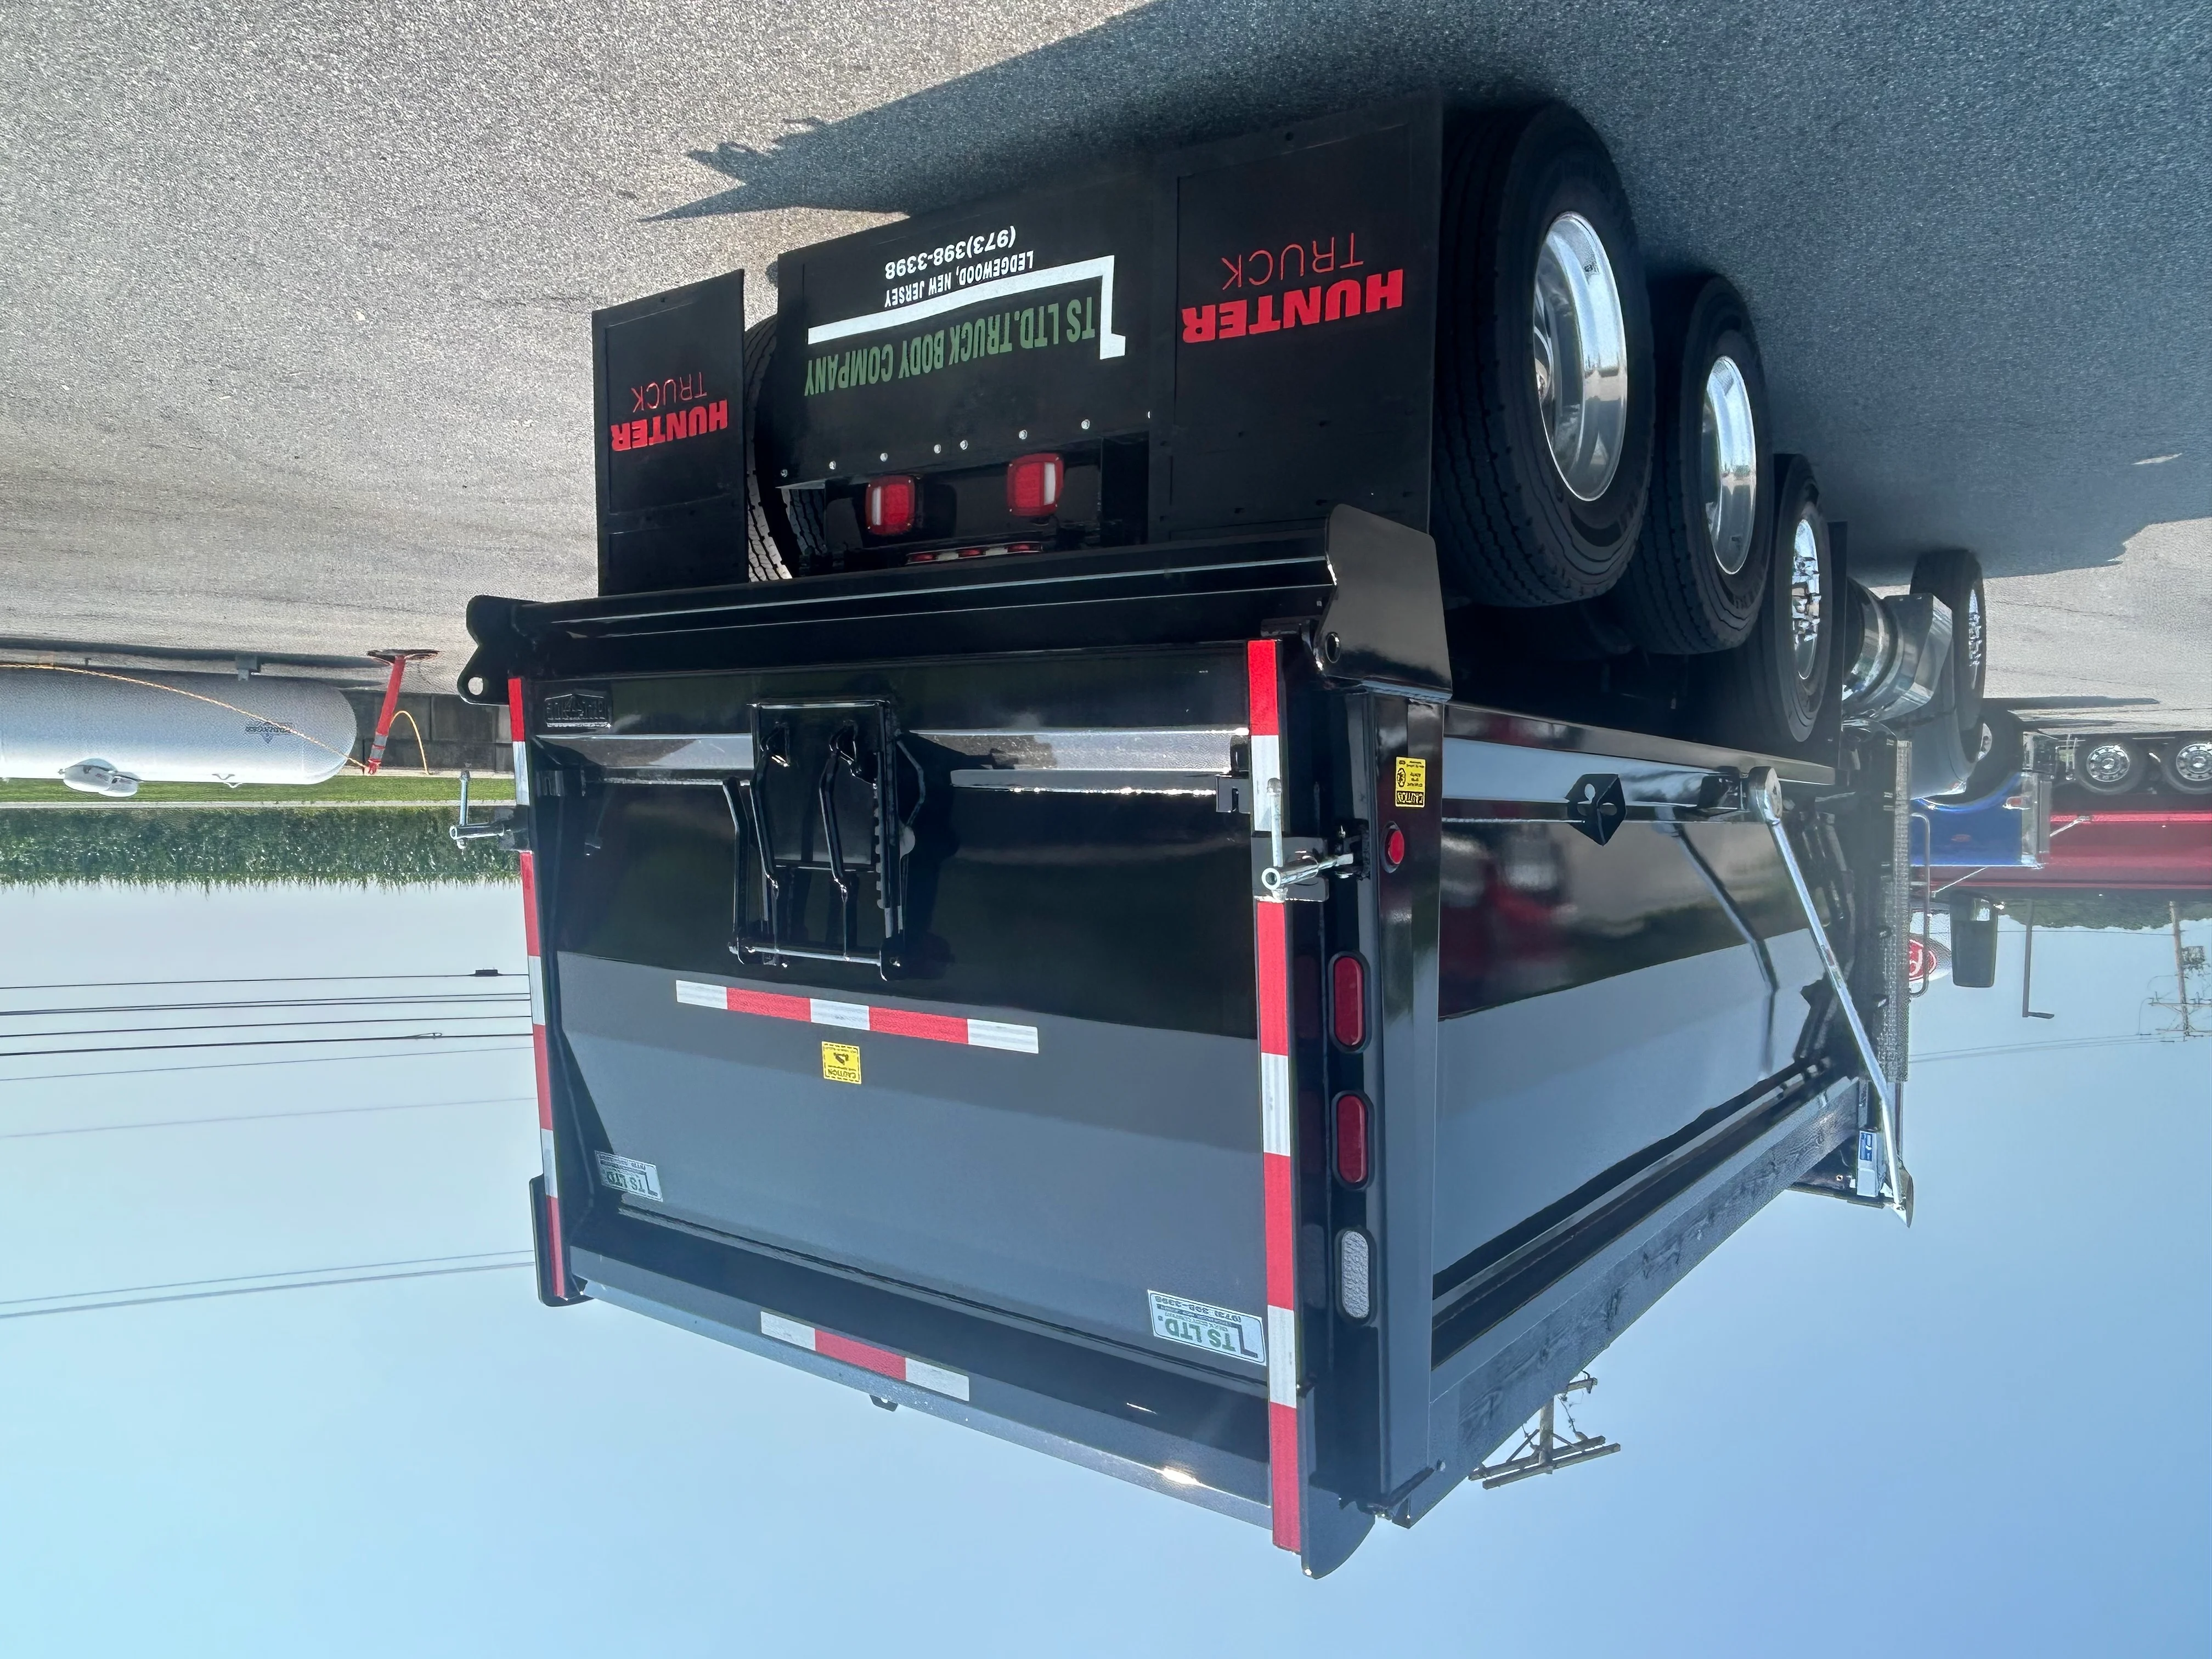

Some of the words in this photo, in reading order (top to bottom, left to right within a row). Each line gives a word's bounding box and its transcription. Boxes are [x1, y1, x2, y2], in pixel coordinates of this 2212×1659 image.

[884, 225, 1016, 280] (973)398-3398
[956, 250, 1034, 286] LEDGEWOOD,
[1221, 232, 1364, 291] TRUCK
[884, 280, 925, 308] JERSEY
[928, 272, 952, 296] NEW
[1066, 297, 1095, 343] TS
[1181, 268, 1404, 344] HUNTER
[804, 343, 894, 396] COMPANY
[898, 329, 945, 379] BODY
[630, 371, 707, 413] TRUCK
[610, 399, 729, 452] HUNTER
[1397, 792, 1423, 804] CAUTION
[827, 1068, 856, 1079] CAUTION
[1158, 1316, 1201, 1342] LTD.
[1207, 1329, 1235, 1351] TS
